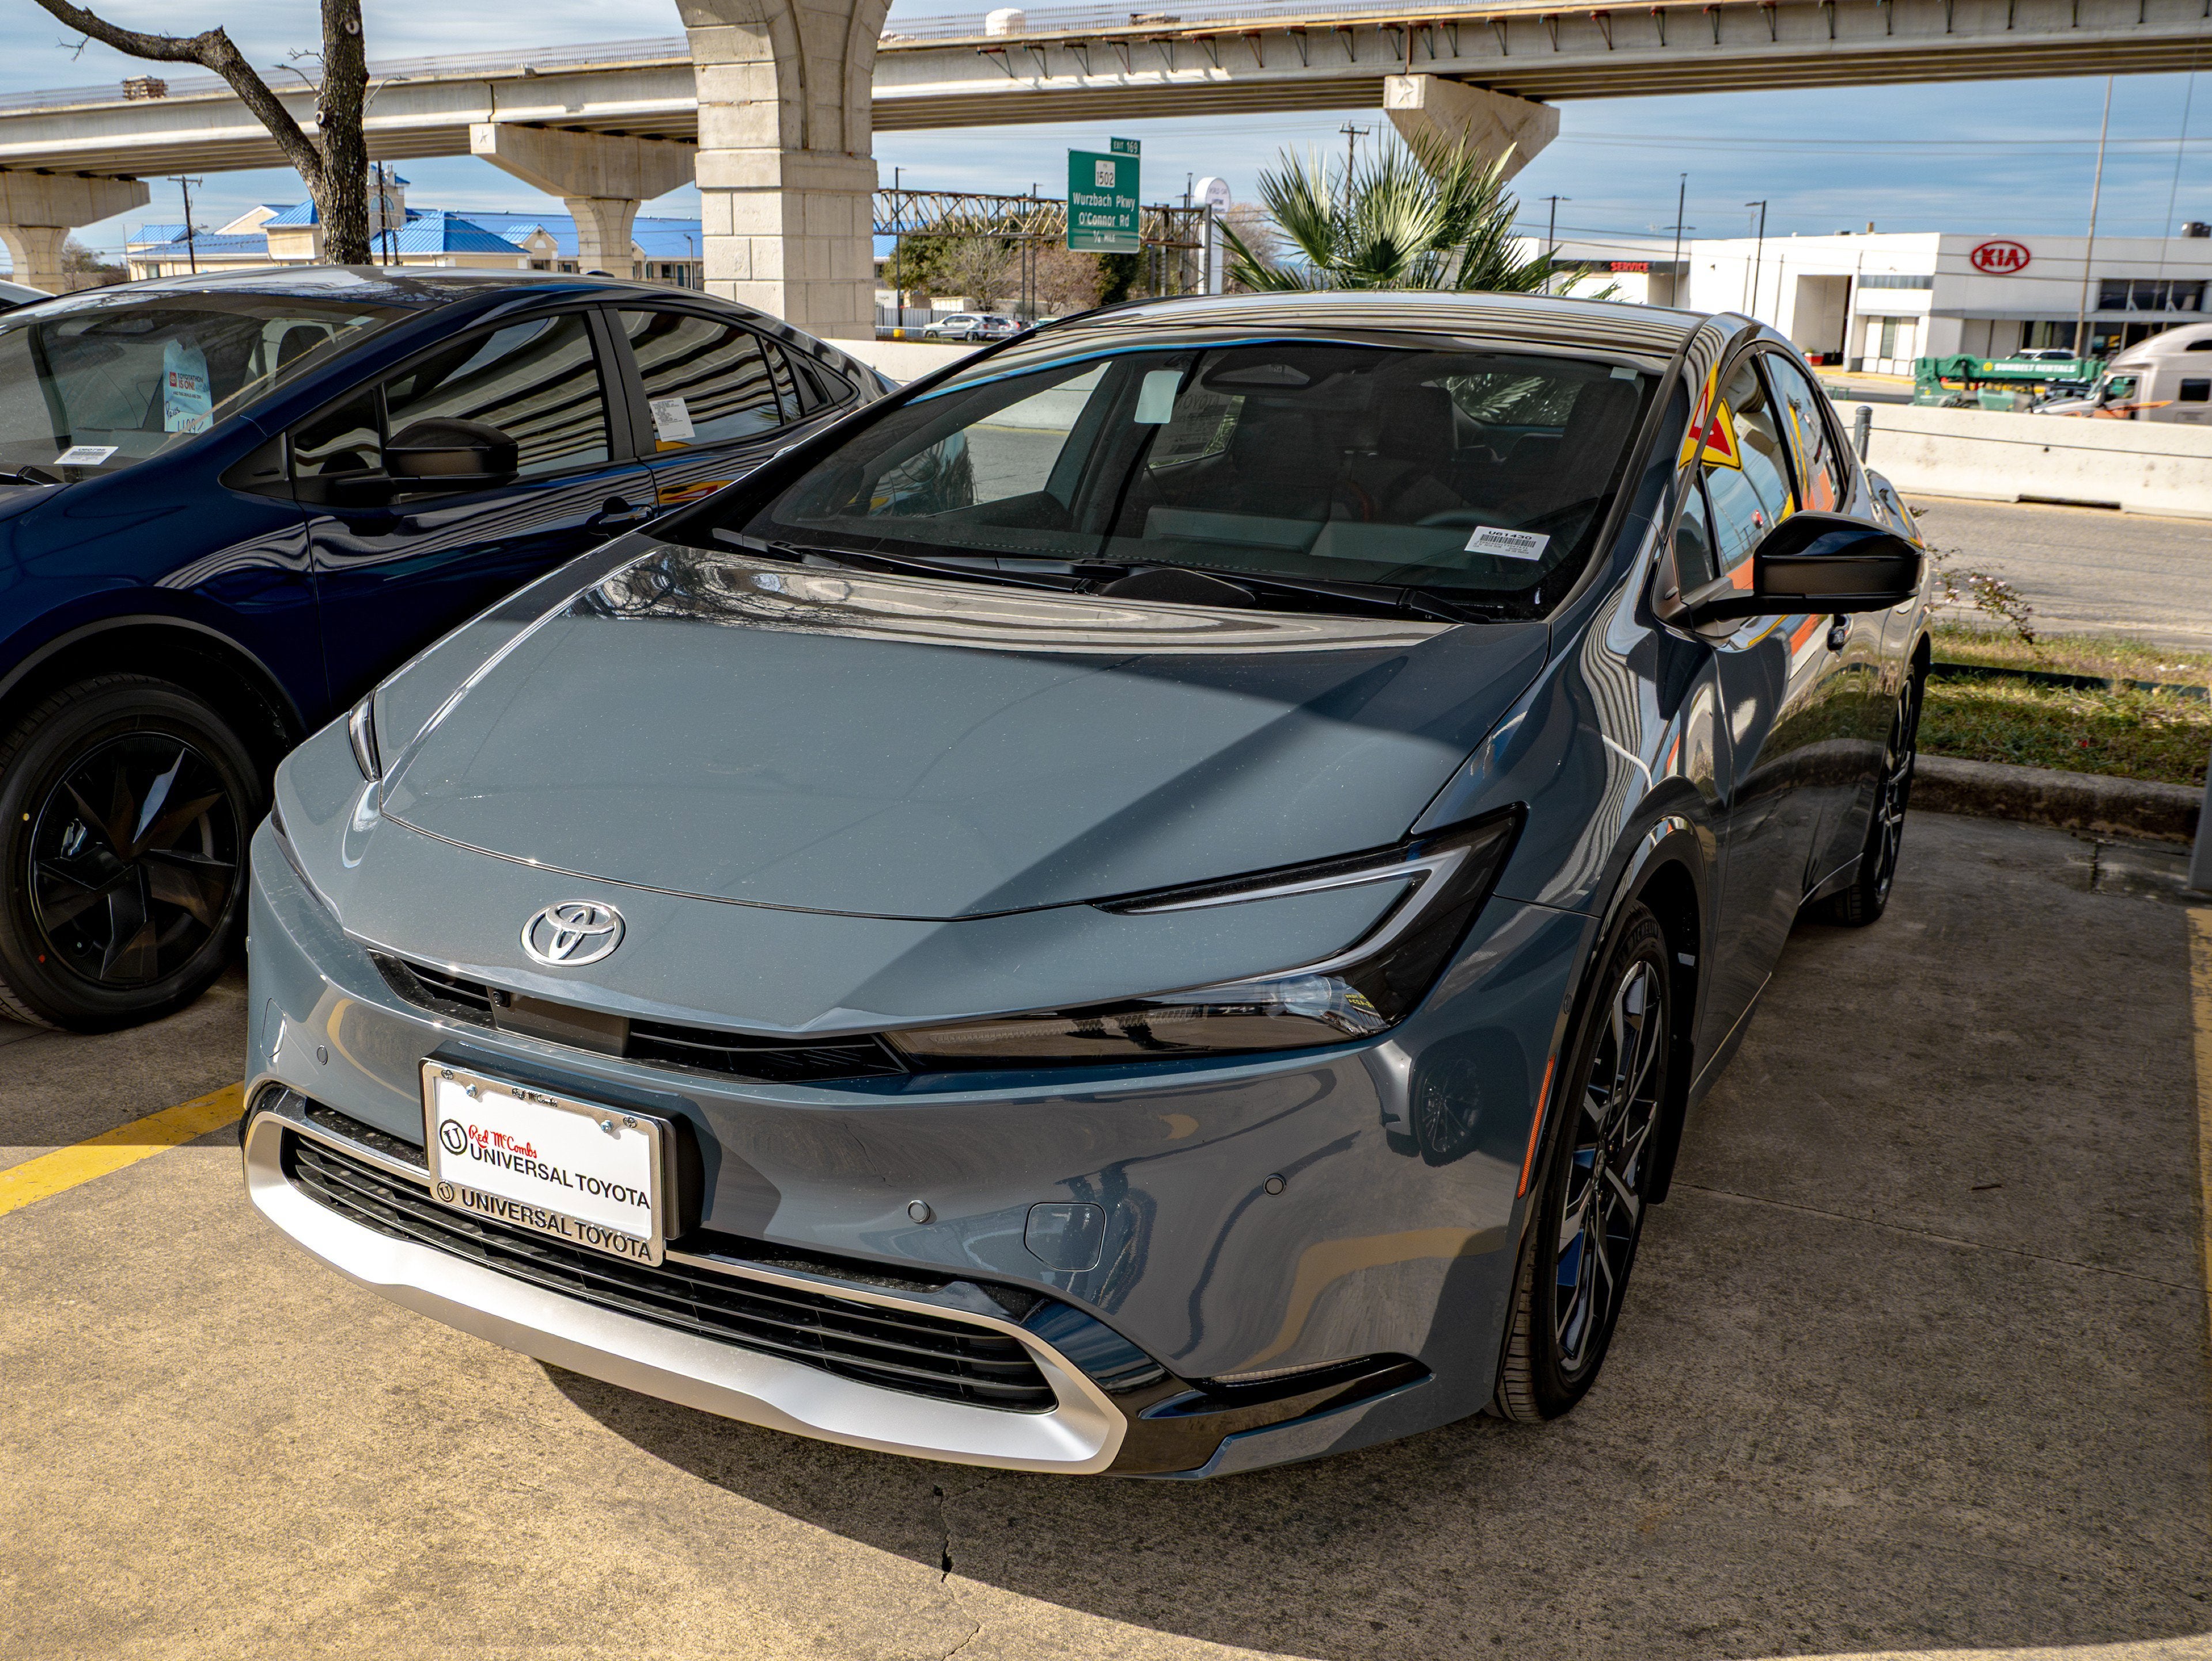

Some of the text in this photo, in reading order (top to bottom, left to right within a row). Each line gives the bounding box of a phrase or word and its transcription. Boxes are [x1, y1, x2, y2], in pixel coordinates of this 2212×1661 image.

[1113, 141, 1138, 153] EXIT 169
[1097, 171, 1114, 186] 1502
[1073, 192, 1135, 212] Wurzbach Pkwy
[1078, 211, 1130, 227] O'Connor Rd
[1980, 248, 2020, 266] KIA
[1610, 262, 1649, 272] SERVICE
[2035, 364, 2077, 373] RENTALS
[179, 380, 184, 388] IS
[1488, 531, 1532, 540] U61430
[469, 1125, 490, 1149] Red
[470, 1143, 651, 1210] UNIVERSAL TOYOTA
[461, 1188, 572, 1238] UNIVERSAL
[574, 1220, 653, 1262] TOYOTA
